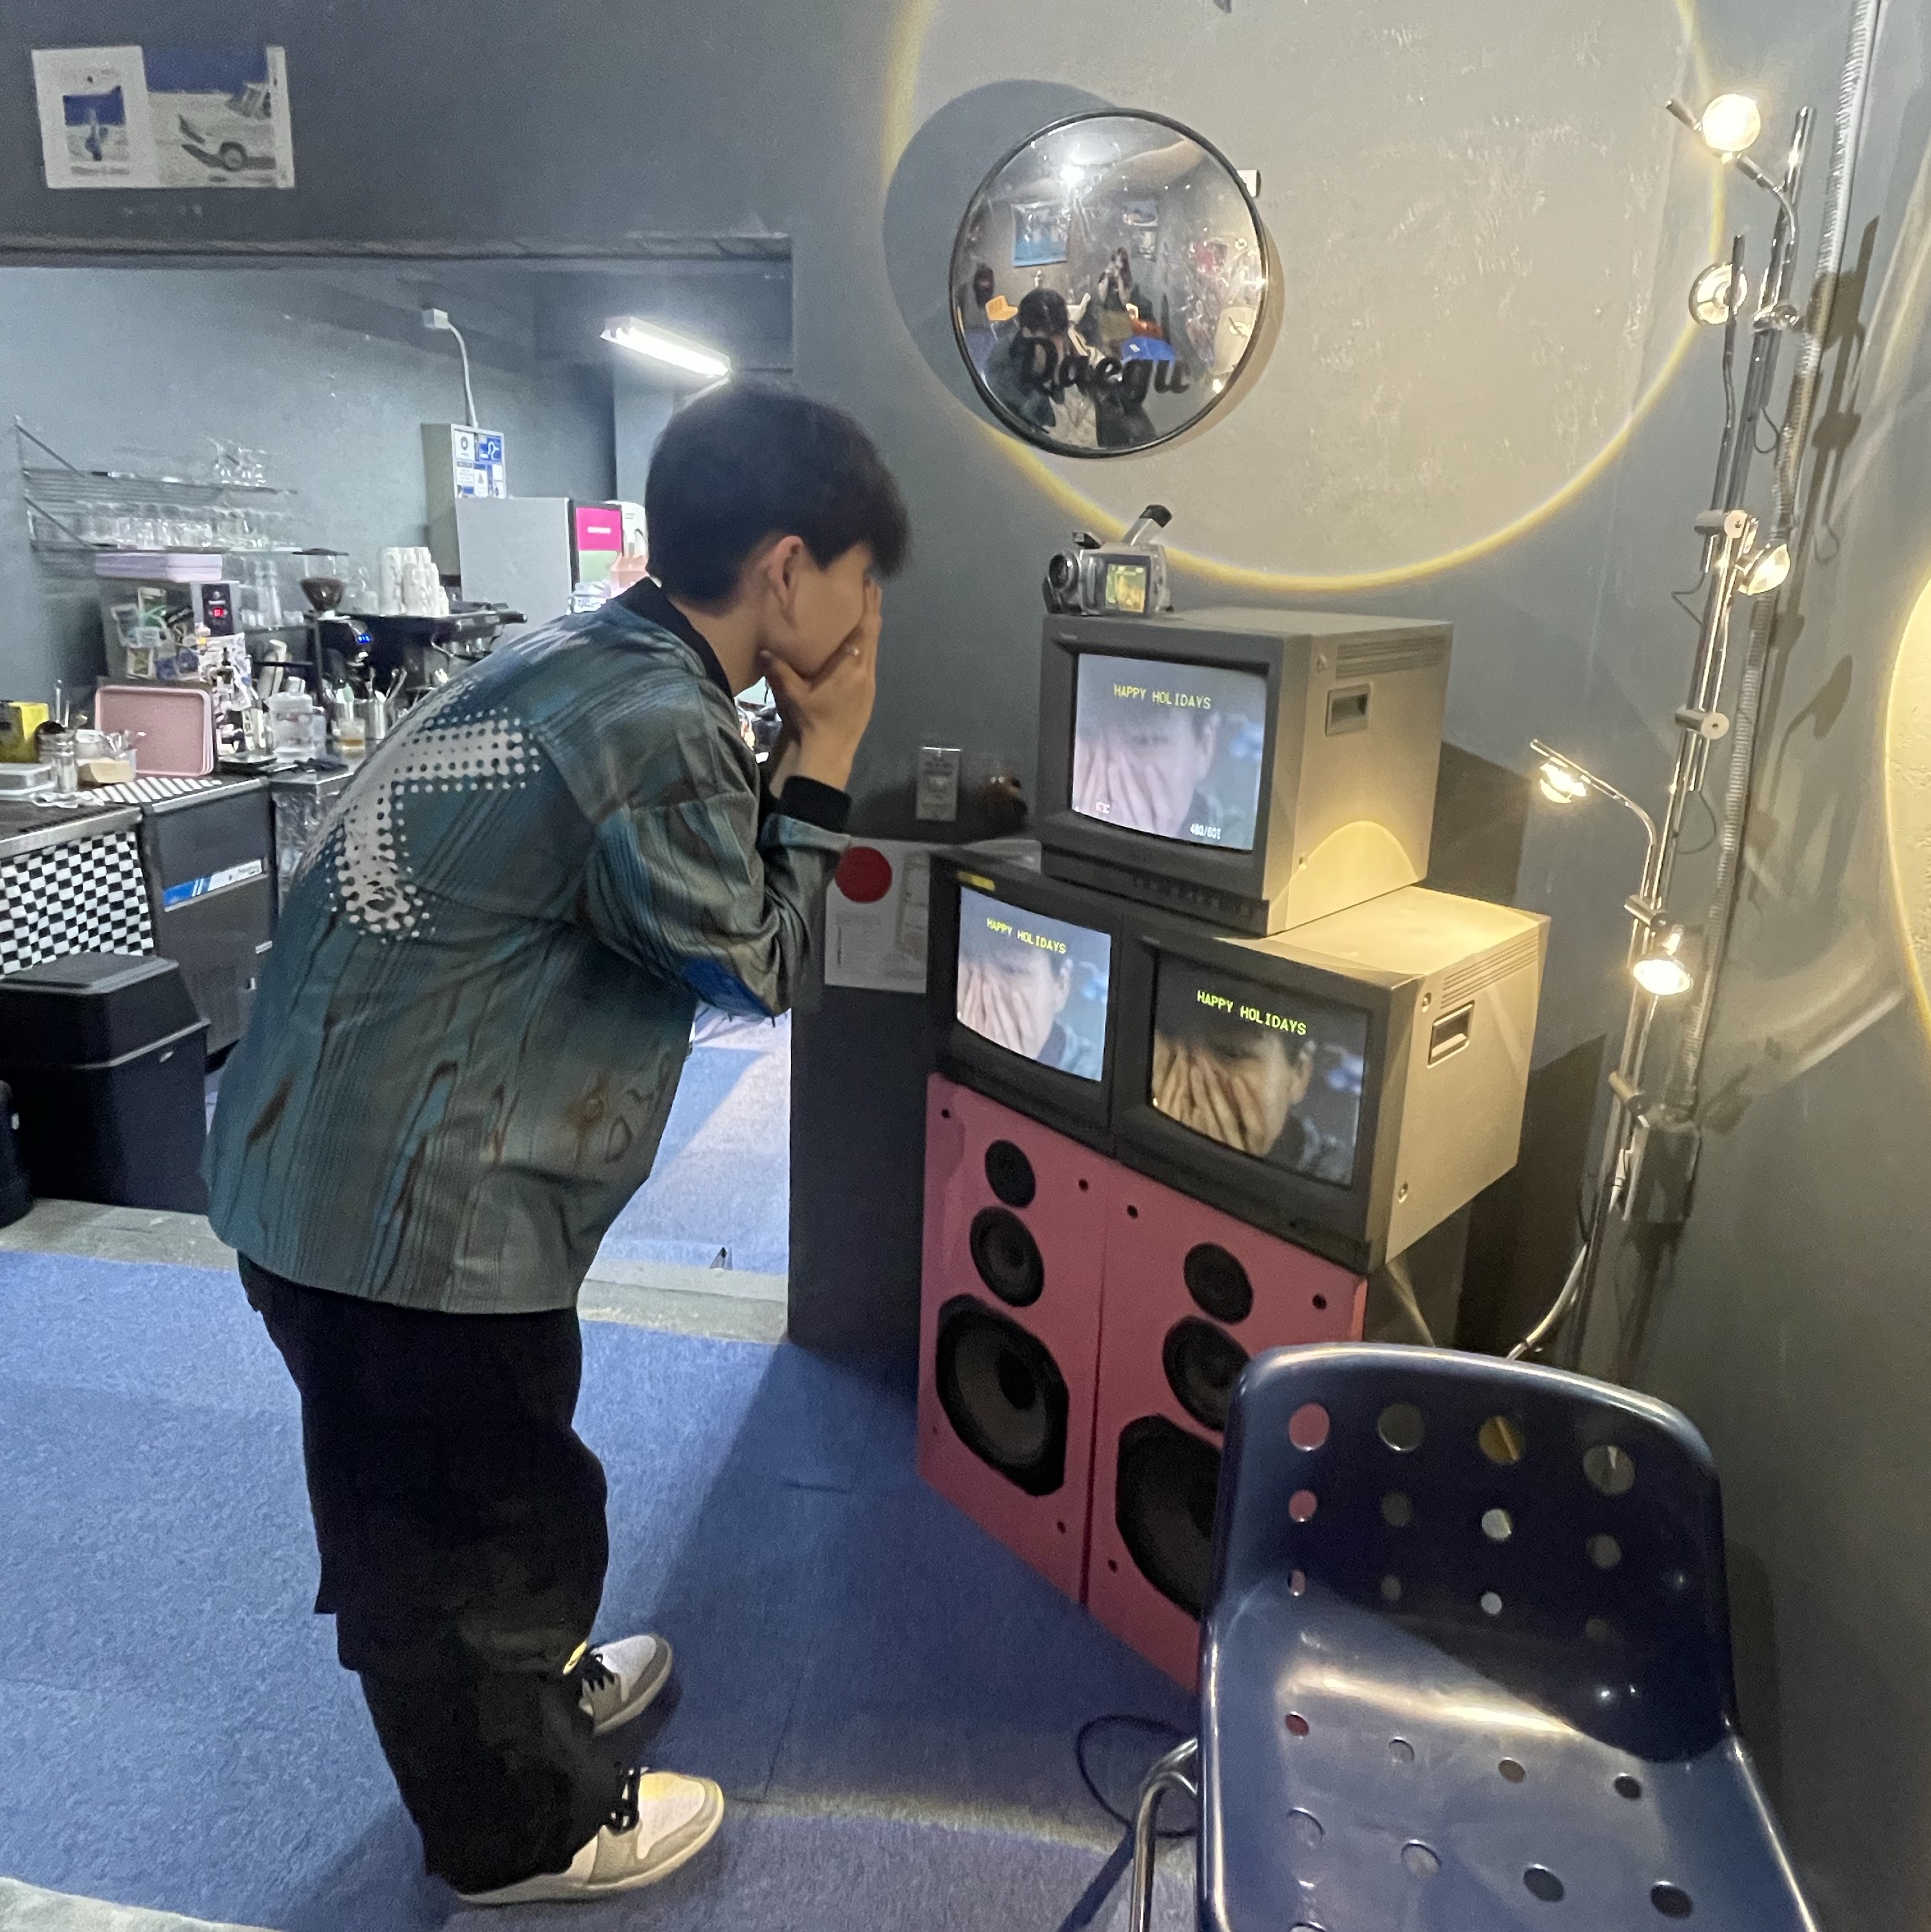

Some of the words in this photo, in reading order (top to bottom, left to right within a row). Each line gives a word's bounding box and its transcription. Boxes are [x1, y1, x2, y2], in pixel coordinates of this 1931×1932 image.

[1018, 337, 1189, 413] Daegu
[1113, 683, 1147, 700] HAPPY
[1152, 690, 1211, 710] HOLIDAYS
[986, 917, 1013, 937] HAPPY
[1016, 930, 1066, 954] HOLIDAYS
[1197, 990, 1233, 1013] HAPPY
[1239, 1005, 1307, 1036] HOLIDAYS
